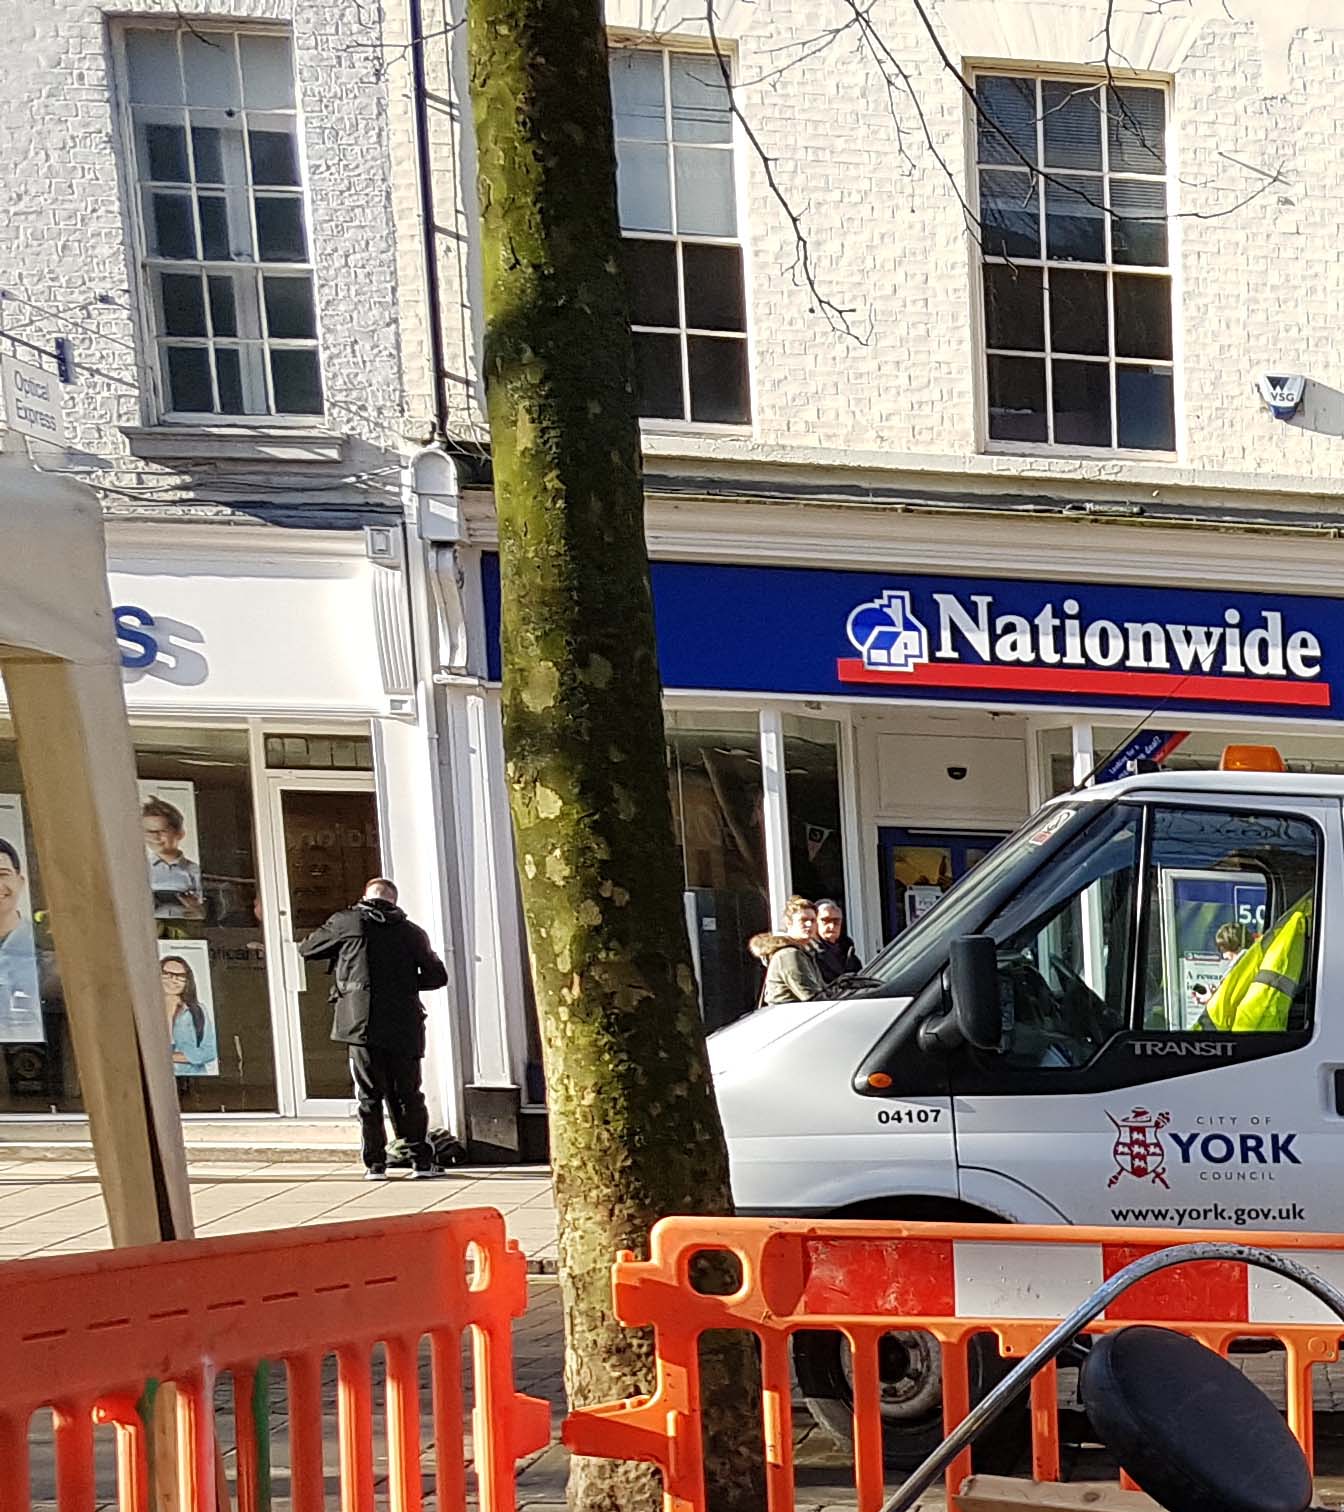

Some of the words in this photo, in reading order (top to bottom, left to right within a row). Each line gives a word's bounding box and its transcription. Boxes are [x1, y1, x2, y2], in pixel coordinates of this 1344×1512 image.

[932, 592, 1322, 678] Nationwide
[1128, 1040, 1237, 1057] TRANSIT
[877, 1109, 942, 1125] 04107
[1196, 1115, 1238, 1126] CITY
[1250, 1115, 1273, 1125] OF
[1169, 1132, 1302, 1165] YORK
[1199, 1170, 1276, 1182] COUNCIL
[1110, 1202, 1306, 1226] www.york.gov.uk
